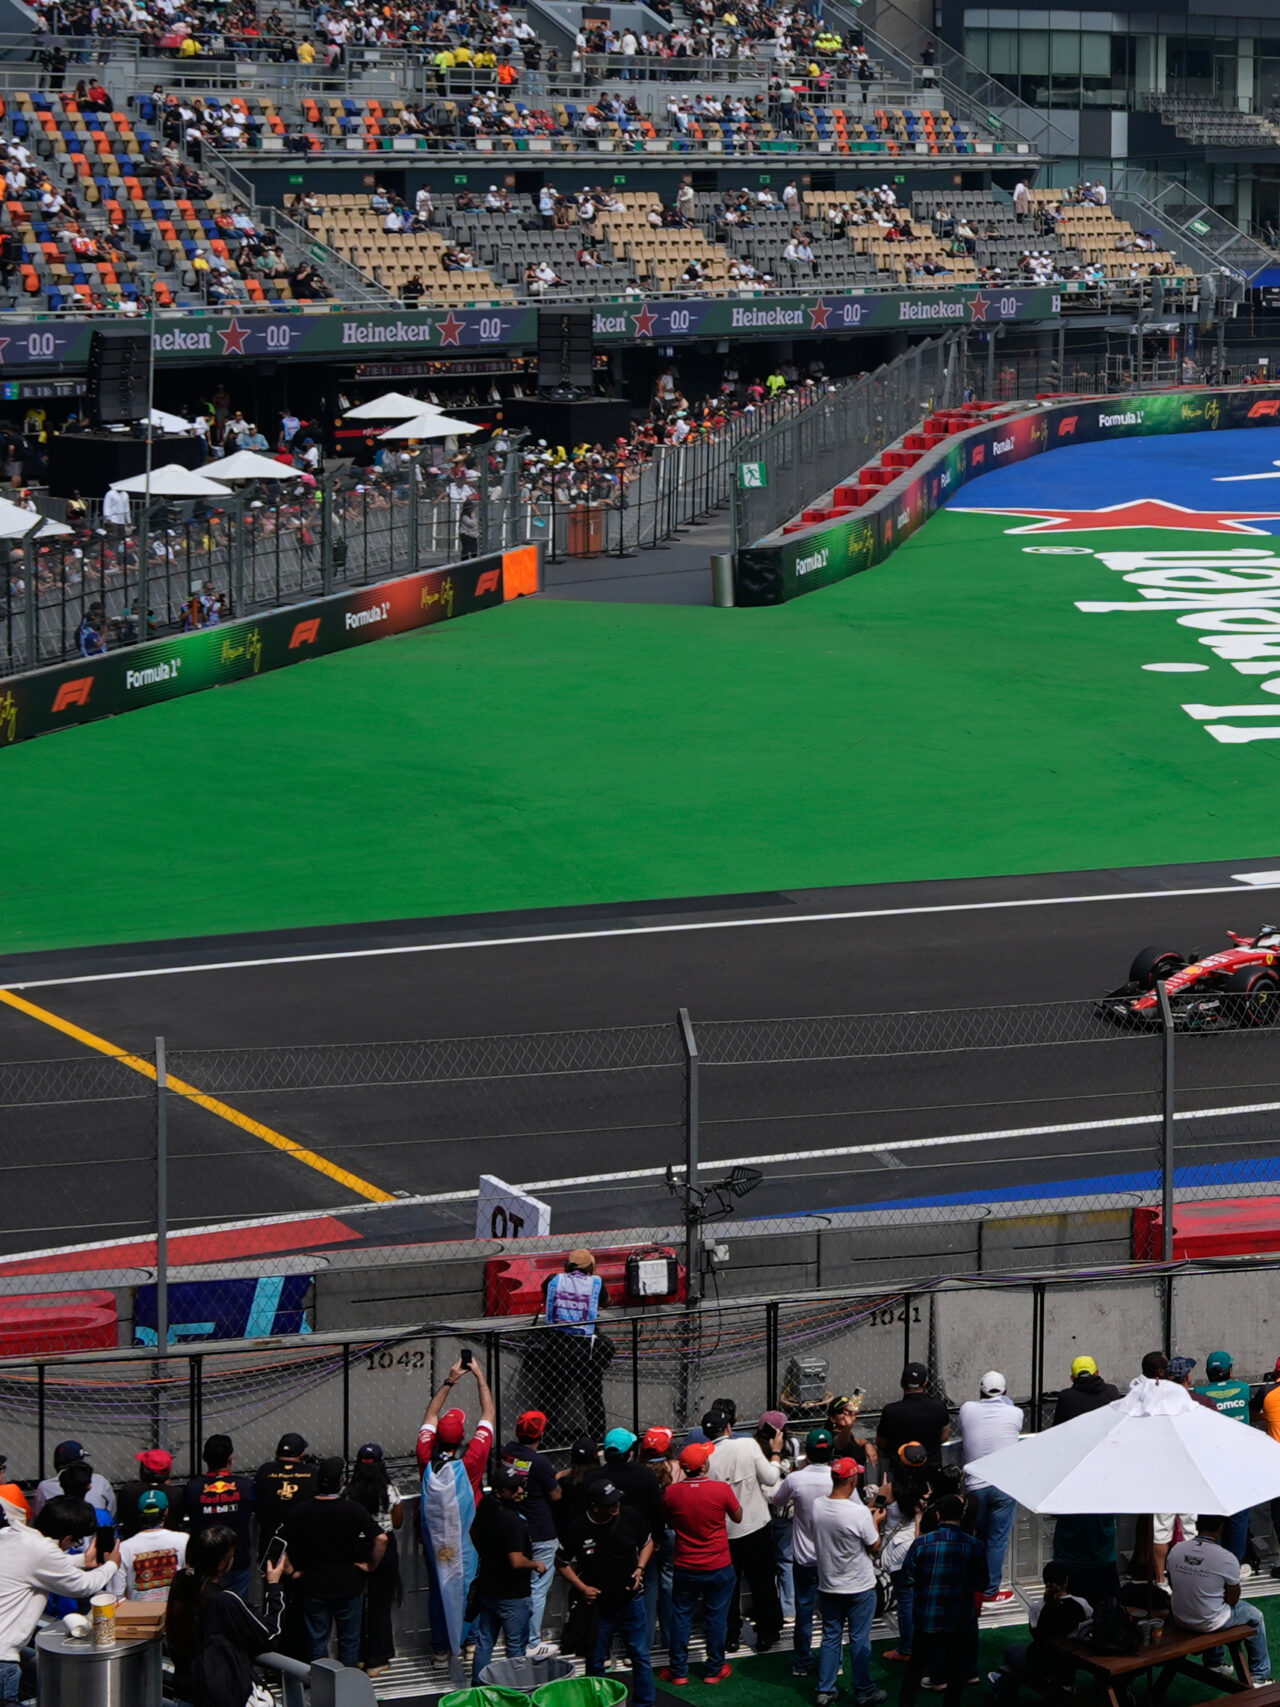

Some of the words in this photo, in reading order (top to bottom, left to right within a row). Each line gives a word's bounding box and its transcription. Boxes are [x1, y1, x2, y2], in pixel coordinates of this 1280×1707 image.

[731, 307, 804, 327] Heineken
[898, 301, 964, 319] Heineken
[152, 329, 212, 350] neken
[342, 321, 430, 343] Heineken
[1099, 411, 1136, 428] Formula
[345, 605, 381, 630] Formula
[127, 661, 169, 689] Formula
[200, 1493, 219, 1503] Red
[220, 1491, 241, 1502] Bull
[203, 1504, 228, 1514] Mobil
